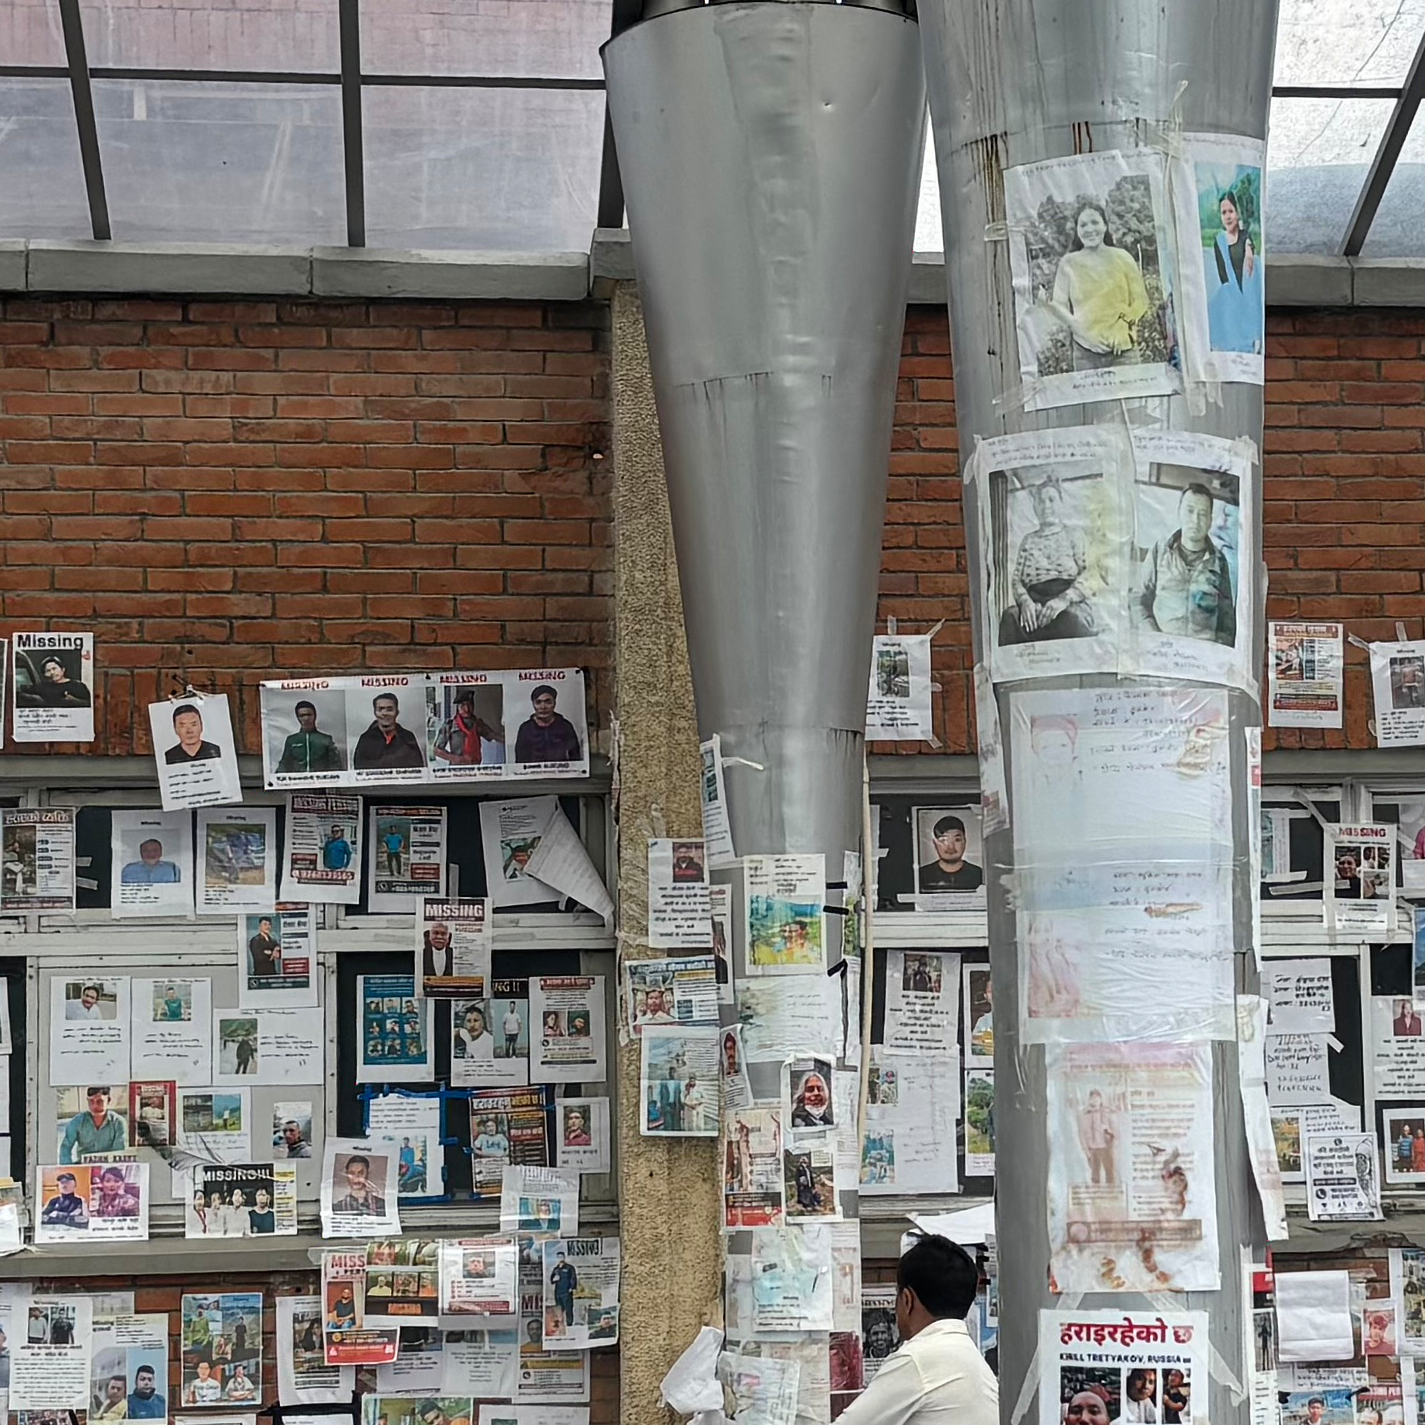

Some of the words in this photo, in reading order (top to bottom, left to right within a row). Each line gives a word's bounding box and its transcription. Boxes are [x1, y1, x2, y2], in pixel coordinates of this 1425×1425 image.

[17, 634, 84, 650] Missing
[425, 904, 484, 917] MISSING
[1060, 1317, 1167, 1347] हराइरहेको
[1172, 1326, 1194, 1344] छ
[1147, 1355, 1181, 1364] RUSSIA
